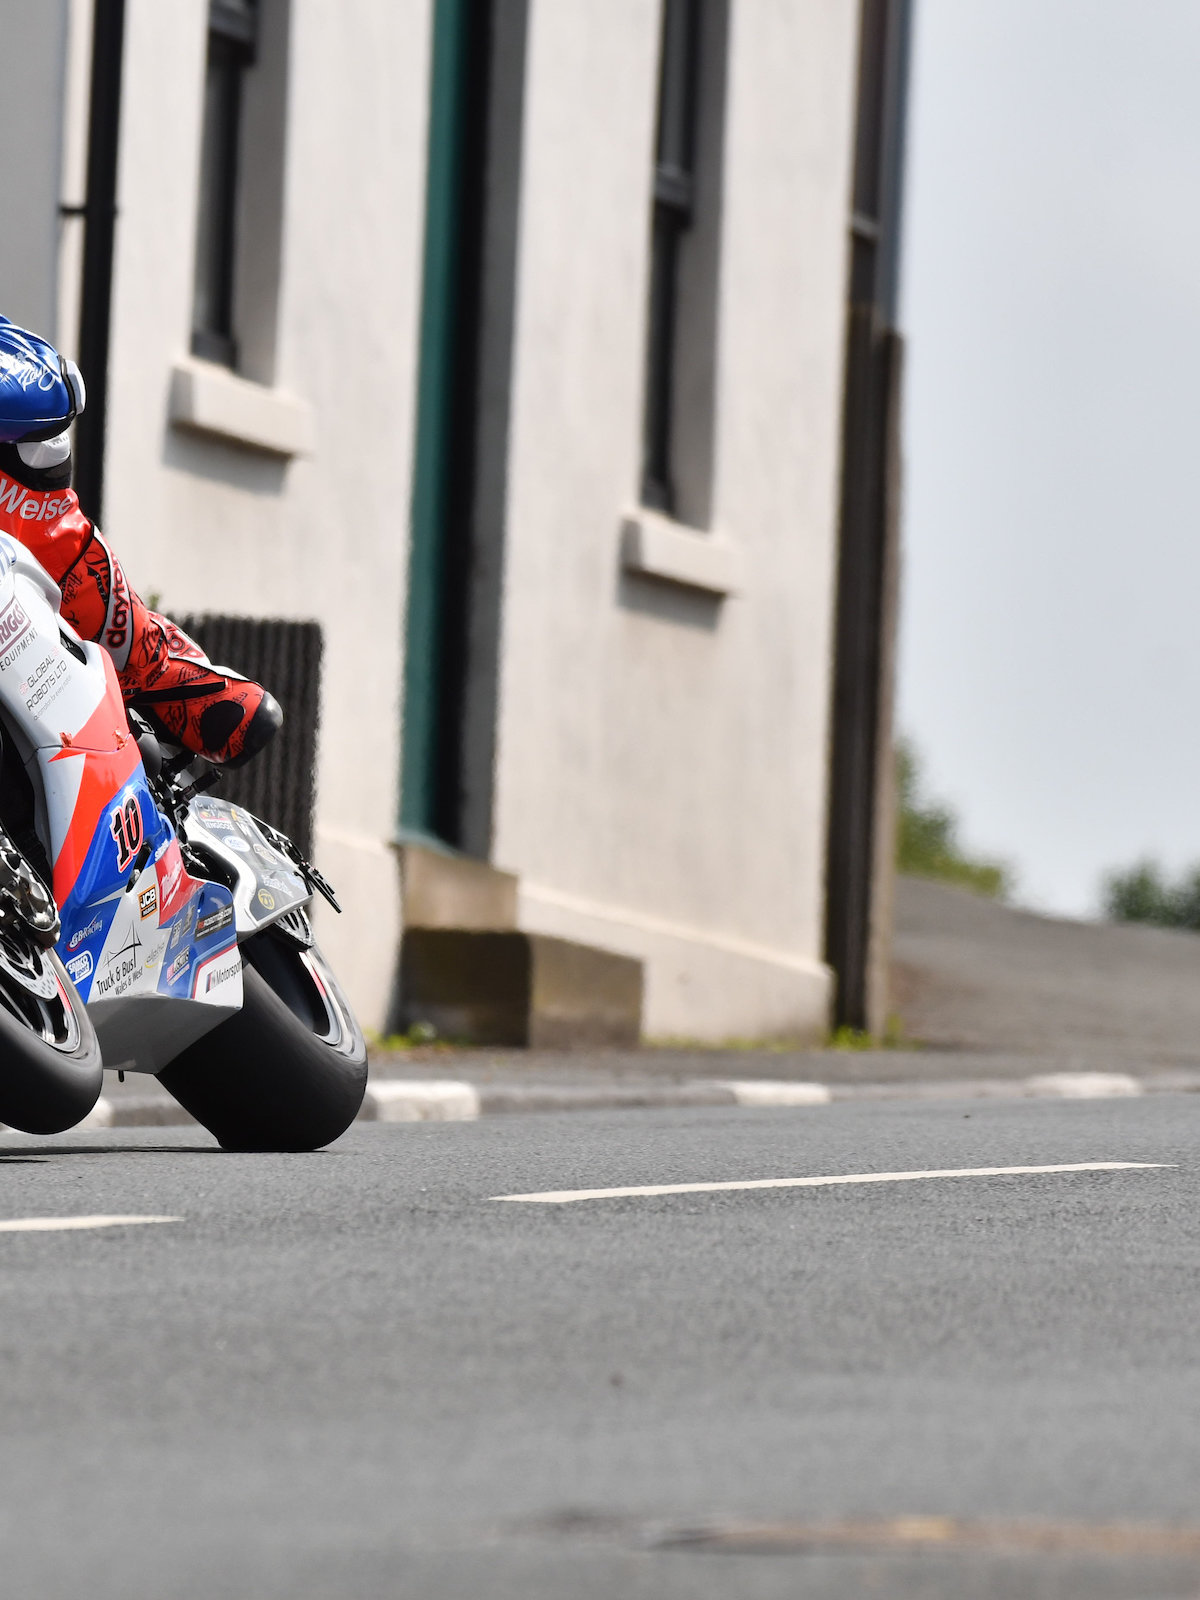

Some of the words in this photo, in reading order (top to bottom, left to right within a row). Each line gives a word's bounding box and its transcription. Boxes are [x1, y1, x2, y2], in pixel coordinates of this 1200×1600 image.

[0, 627, 39, 672] EQUIPMENT
[25, 673, 57, 712] ROBOTS
[54, 660, 68, 680] LTD
[26, 654, 55, 689] GLOBAL
[110, 794, 144, 873] 10
[140, 888, 156, 909] JCB
[68, 954, 89, 976] SAMCO
[96, 970, 116, 996] Truck
[115, 965, 121, 982] &
[216, 961, 243, 986] Motorspor
[114, 980, 128, 996] Wales
